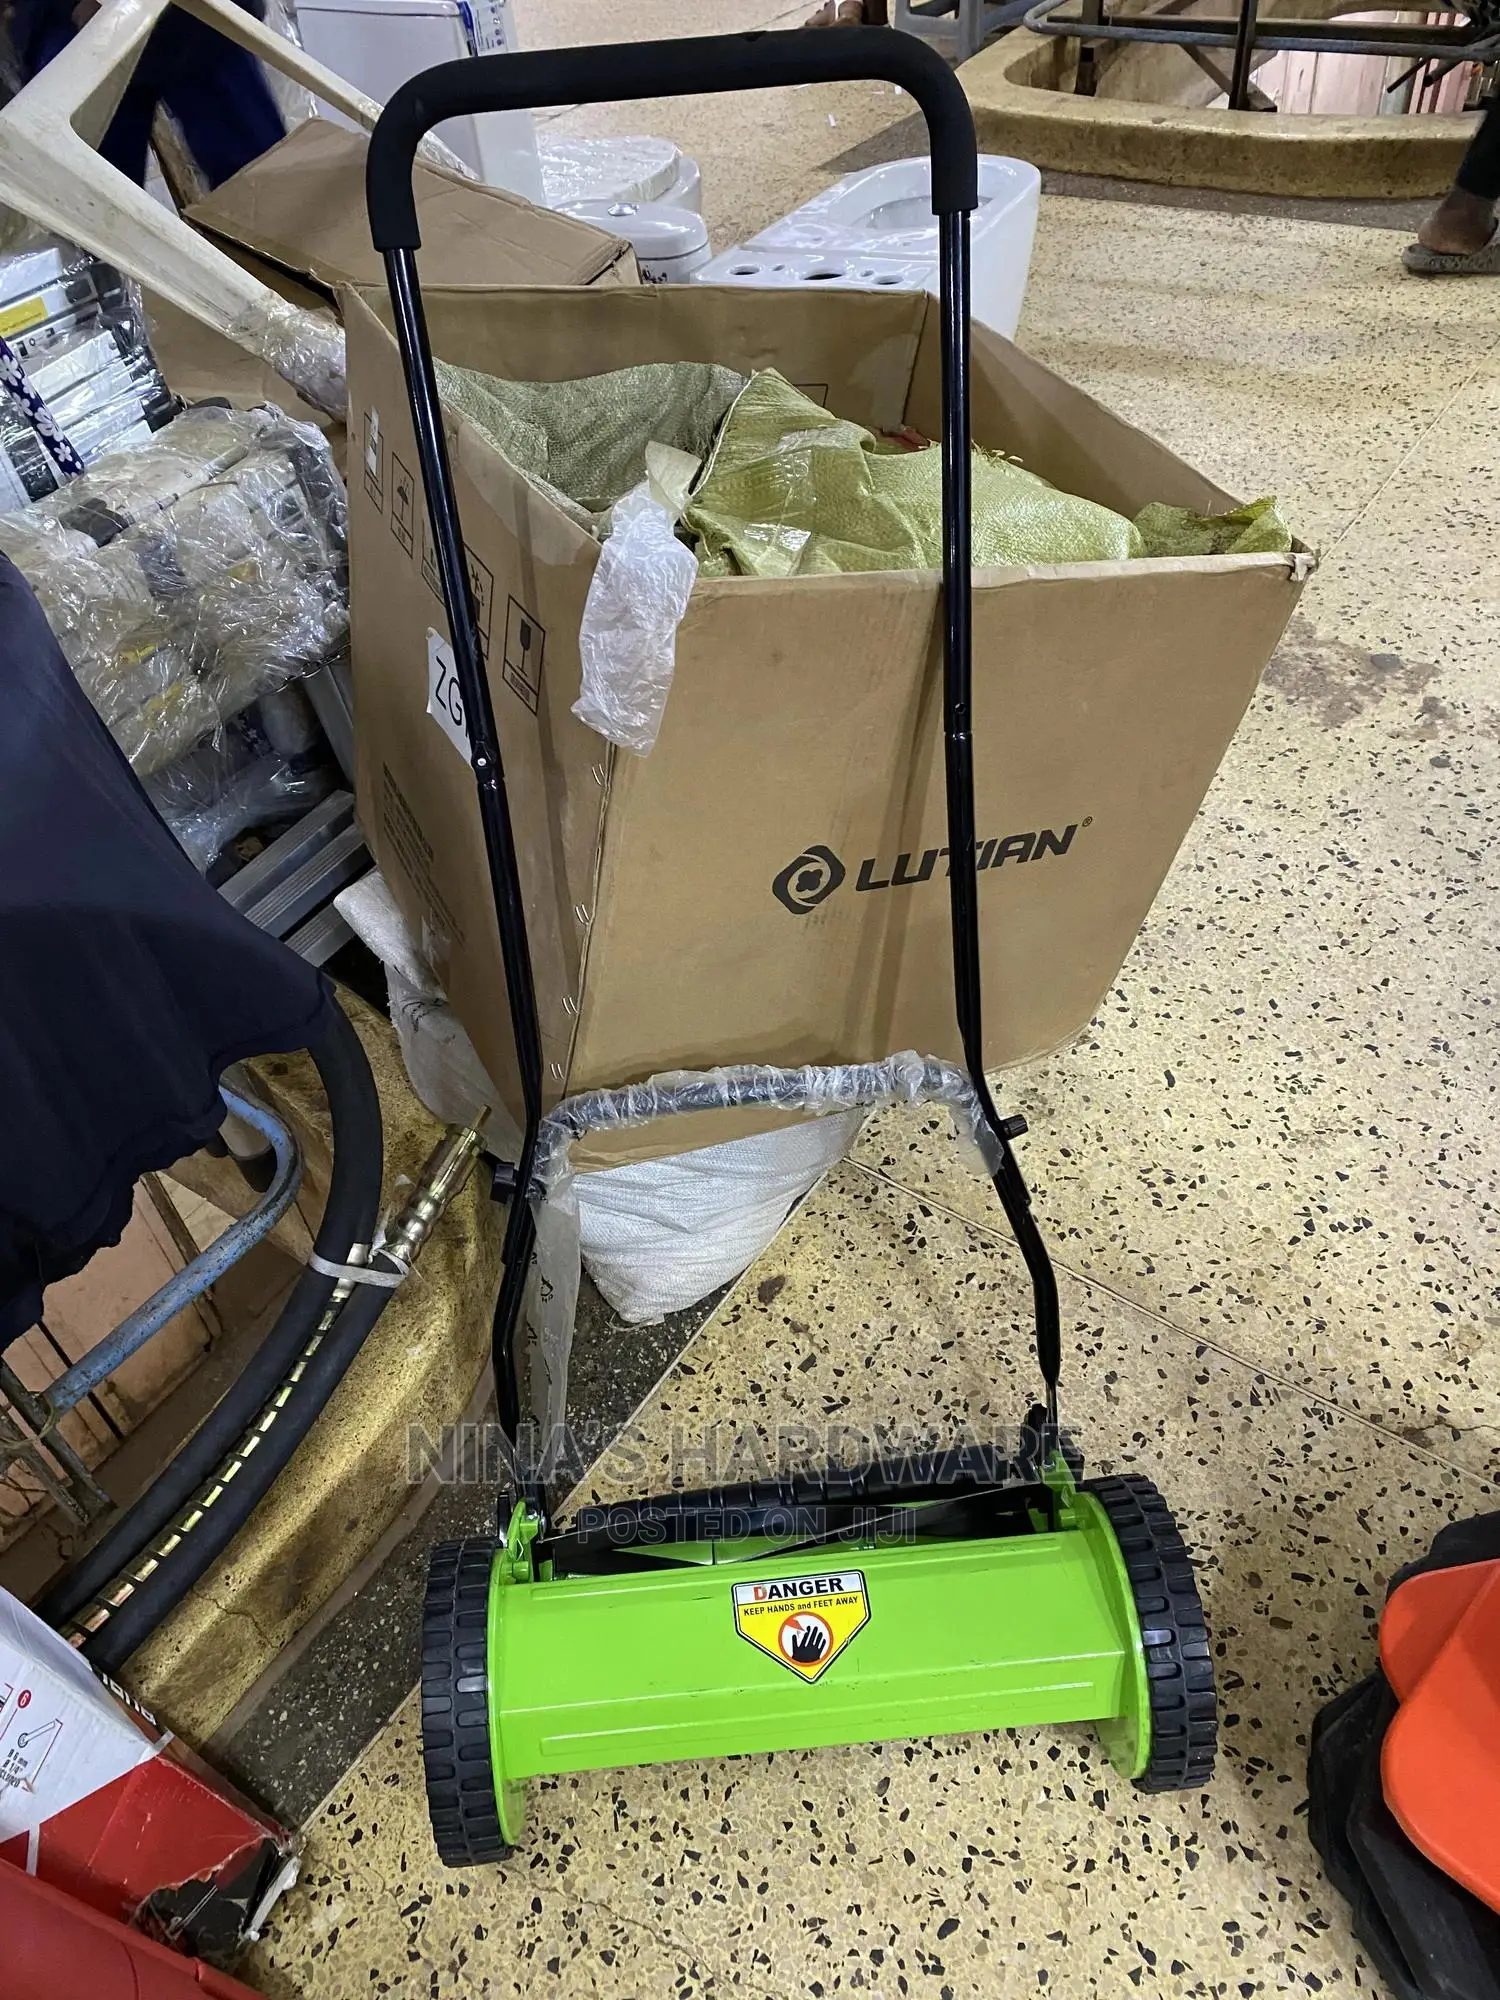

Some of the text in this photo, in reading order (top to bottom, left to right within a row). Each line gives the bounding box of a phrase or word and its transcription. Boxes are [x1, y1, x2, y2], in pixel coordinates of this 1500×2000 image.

[753, 1577, 845, 1601] DANGER
[743, 1595, 859, 1617] KEEP HANDS and FEET AWAY
